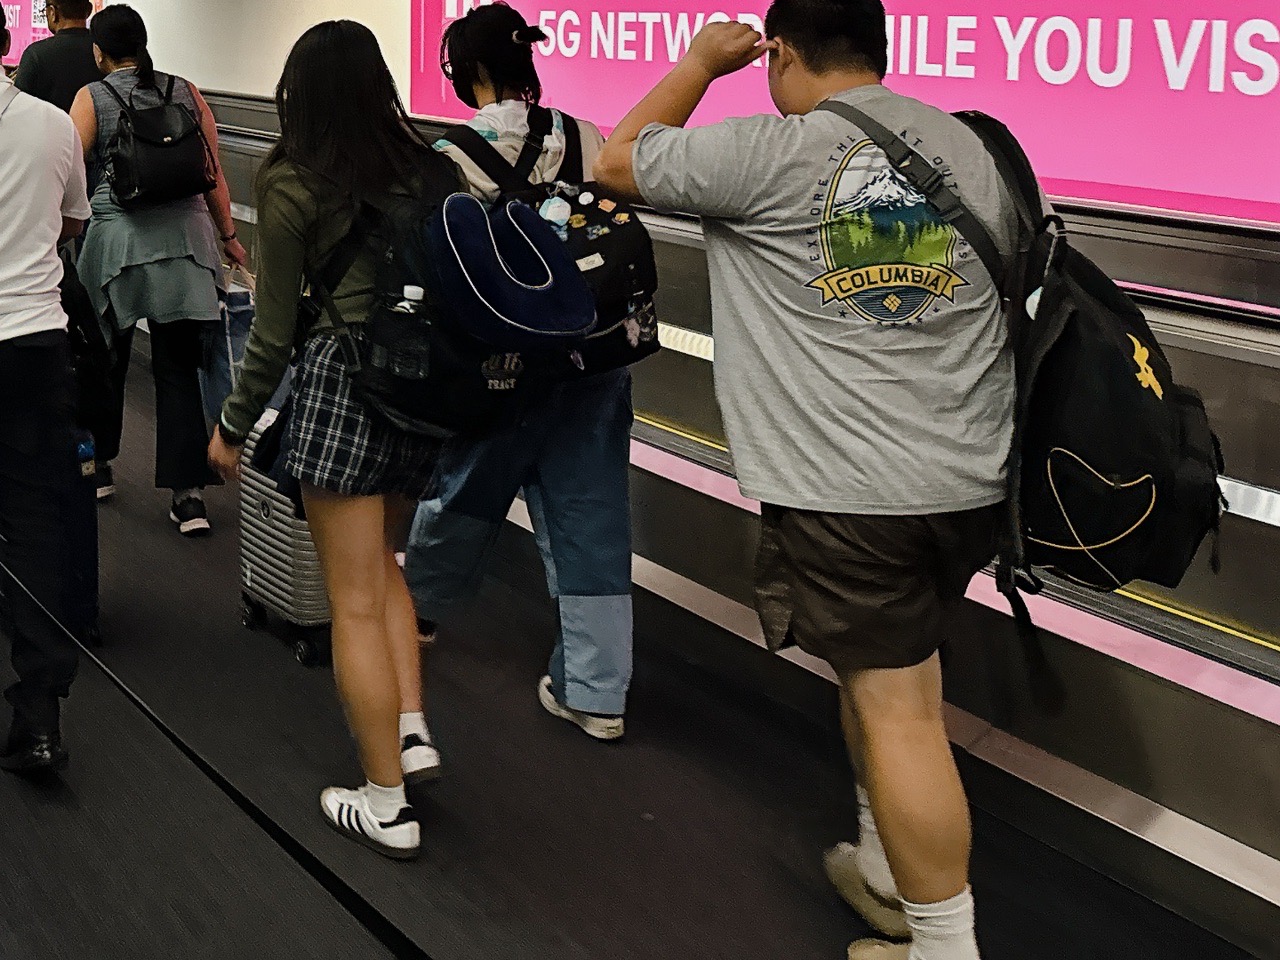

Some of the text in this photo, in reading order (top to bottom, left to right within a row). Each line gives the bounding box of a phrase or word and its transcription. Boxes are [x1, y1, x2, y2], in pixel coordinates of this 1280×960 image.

[537, 10, 582, 58] 5G
[993, 15, 1133, 88] YOU
[1153, 18, 1280, 96] VIS
[836, 267, 942, 294] COLUMBIA
